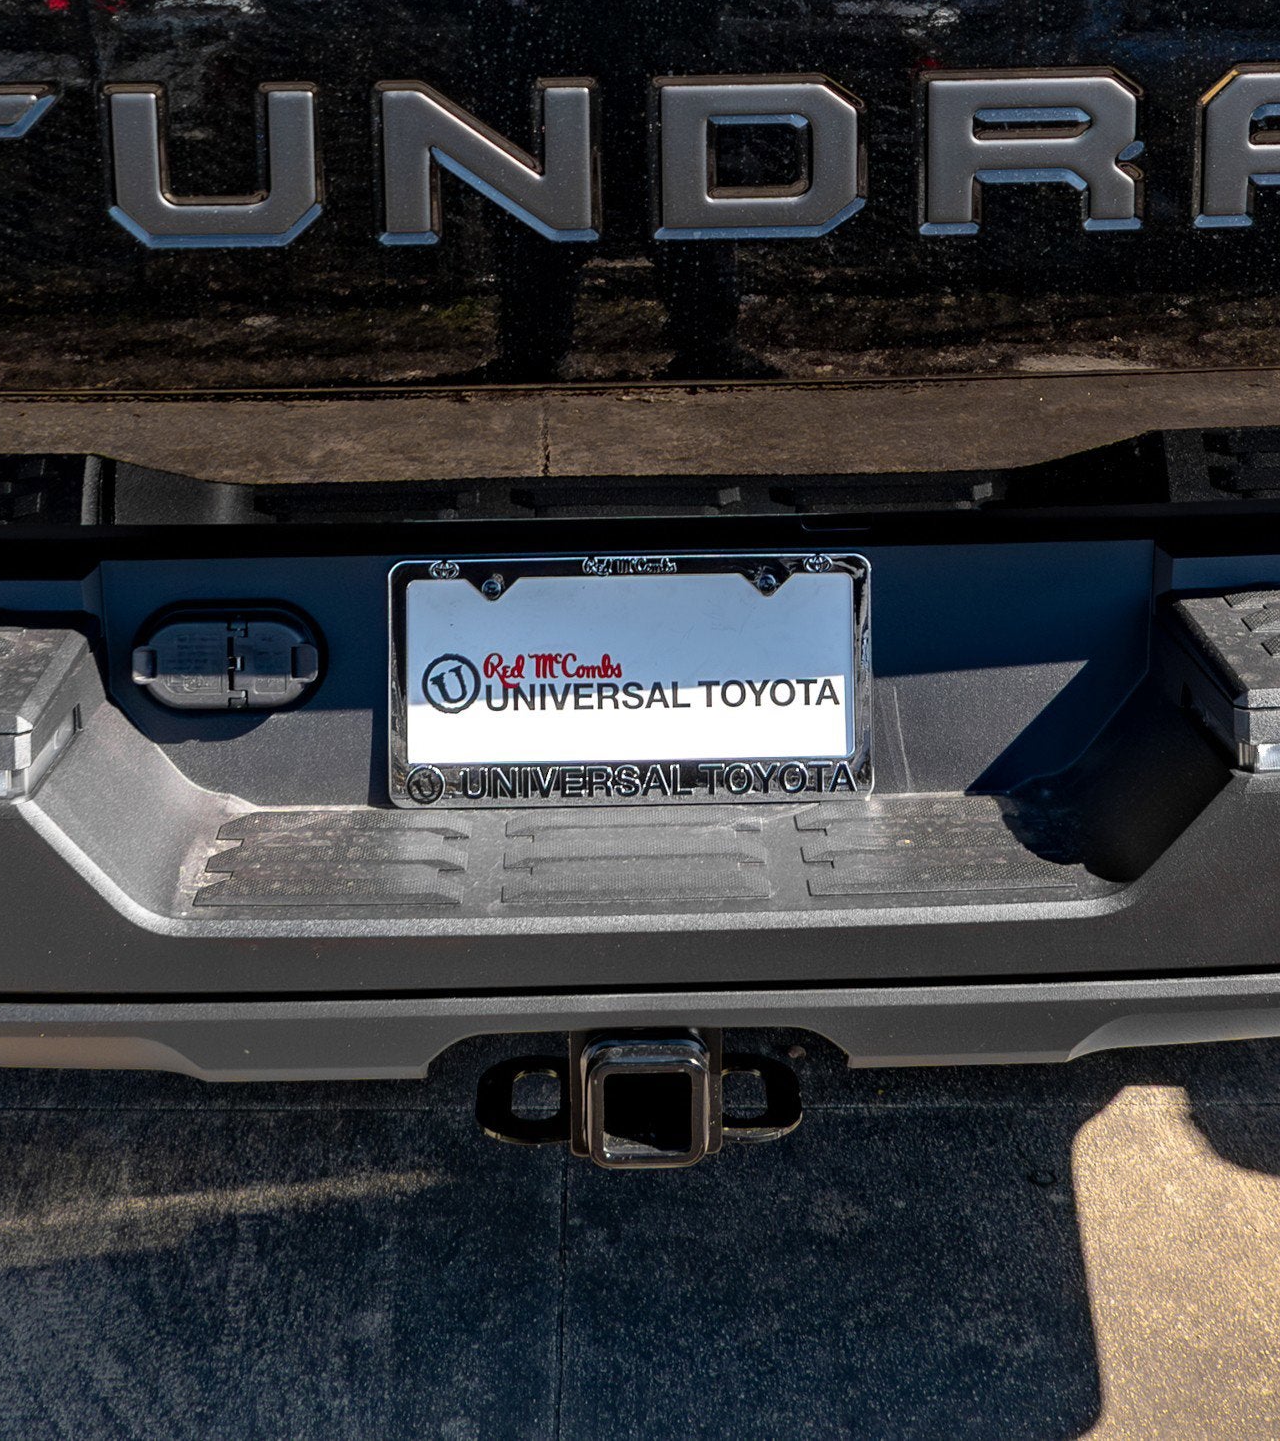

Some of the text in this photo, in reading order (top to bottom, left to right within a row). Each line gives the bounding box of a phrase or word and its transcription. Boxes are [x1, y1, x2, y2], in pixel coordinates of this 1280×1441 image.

[483, 653, 623, 689] Red McCombs
[485, 677, 840, 712] UNIVERSAL TOYOTA
[459, 759, 858, 800] UNIVERSAL TOYOTA
